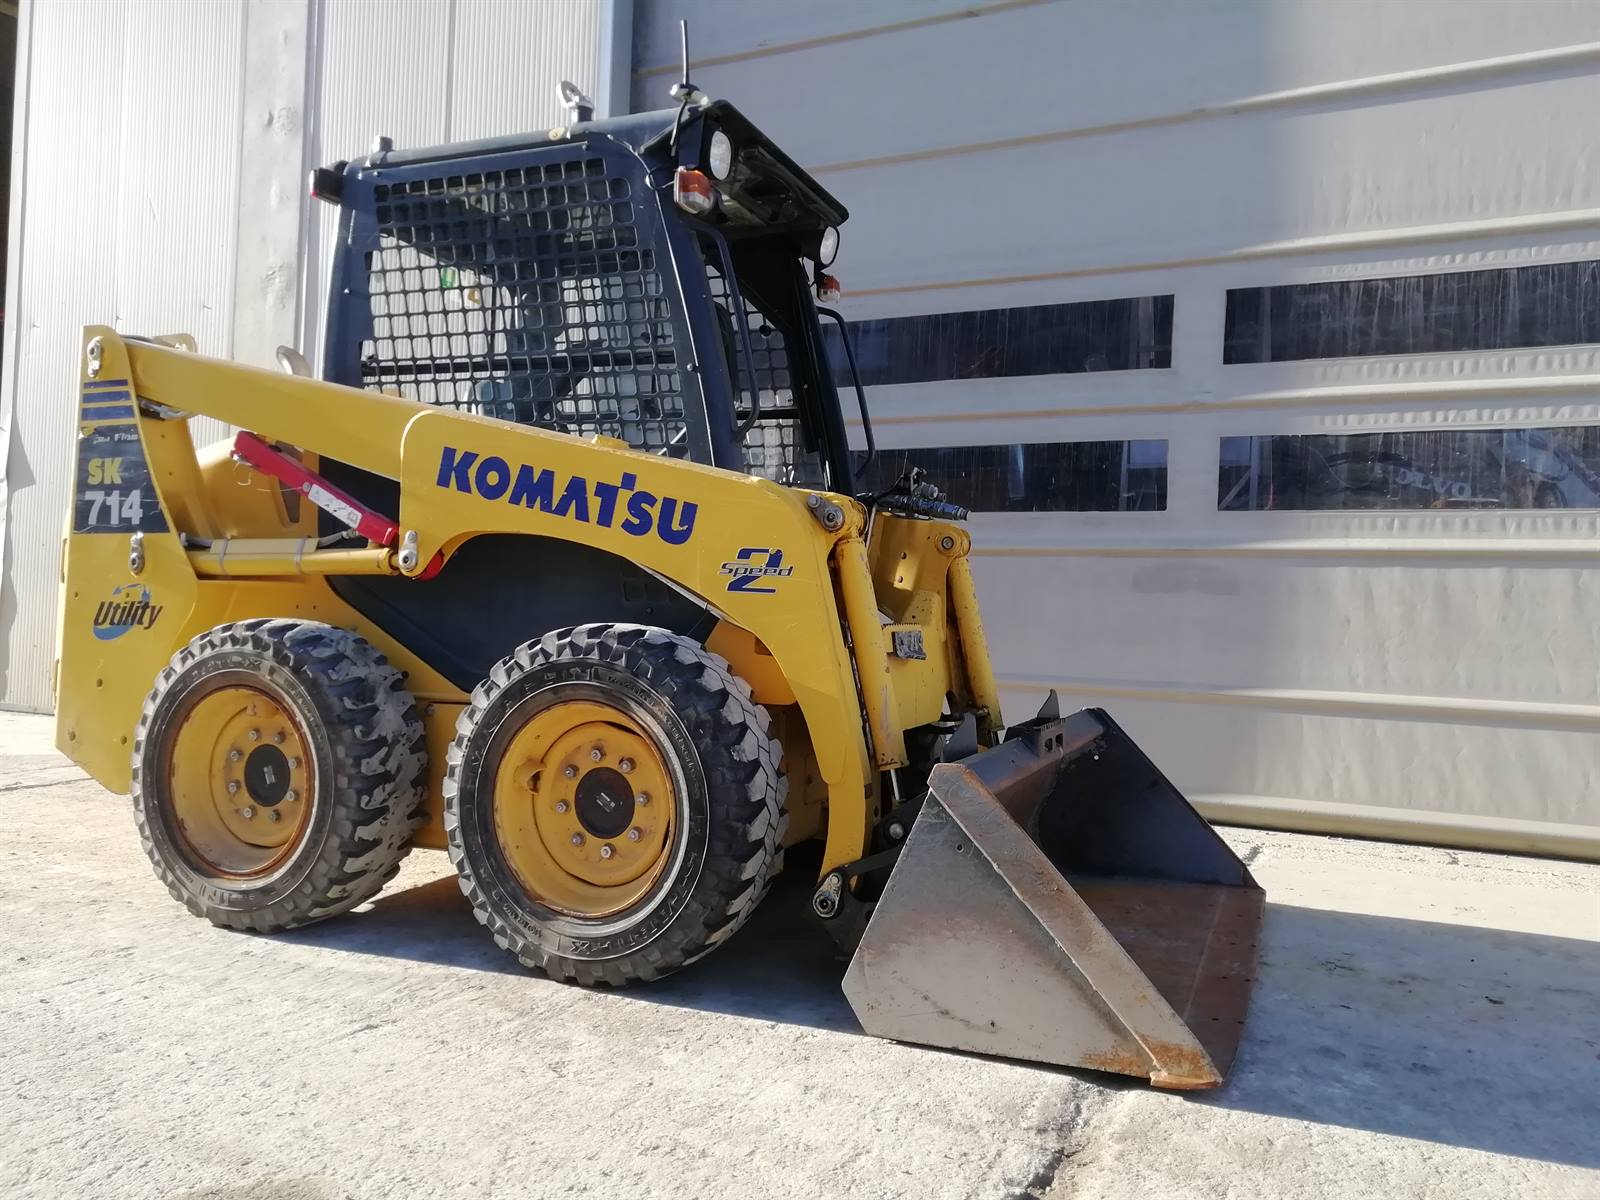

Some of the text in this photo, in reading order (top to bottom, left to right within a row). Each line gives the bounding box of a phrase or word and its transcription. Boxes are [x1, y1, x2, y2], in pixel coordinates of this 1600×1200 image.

[87, 457, 123, 486] SK
[84, 489, 144, 525] 714
[436, 446, 699, 545] KOMATSU
[726, 547, 784, 594] 2
[93, 600, 164, 630] Utility
